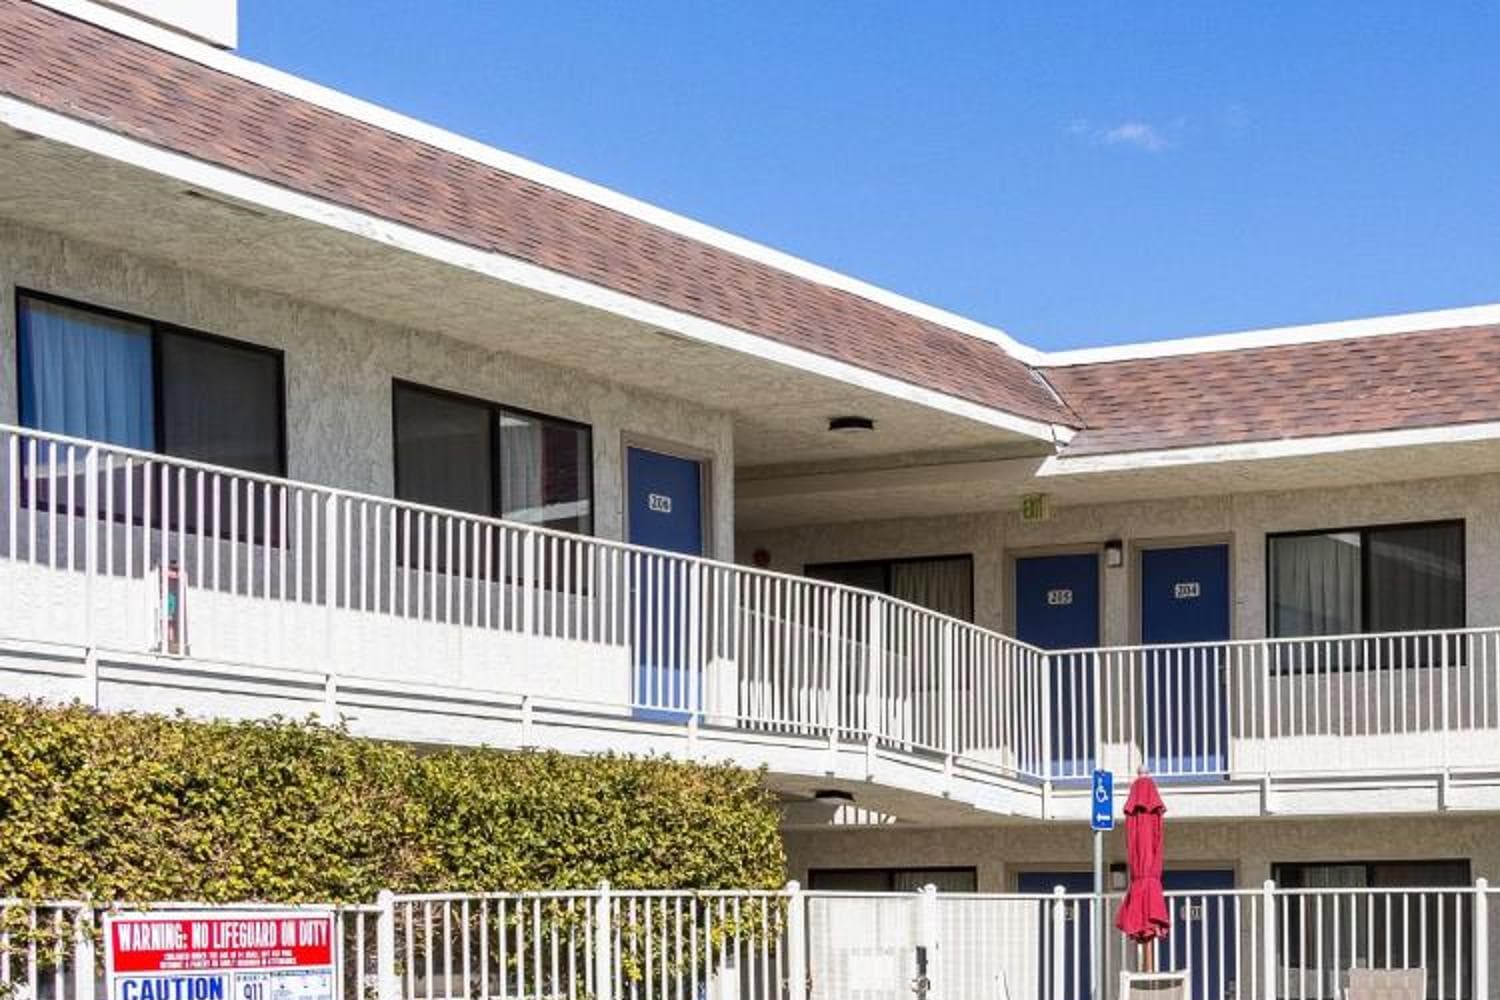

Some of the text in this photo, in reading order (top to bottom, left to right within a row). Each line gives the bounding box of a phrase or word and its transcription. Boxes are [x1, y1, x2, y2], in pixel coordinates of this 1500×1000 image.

[118, 920, 328, 951] WARNING: NO LIFEGUARD ON DUTY
